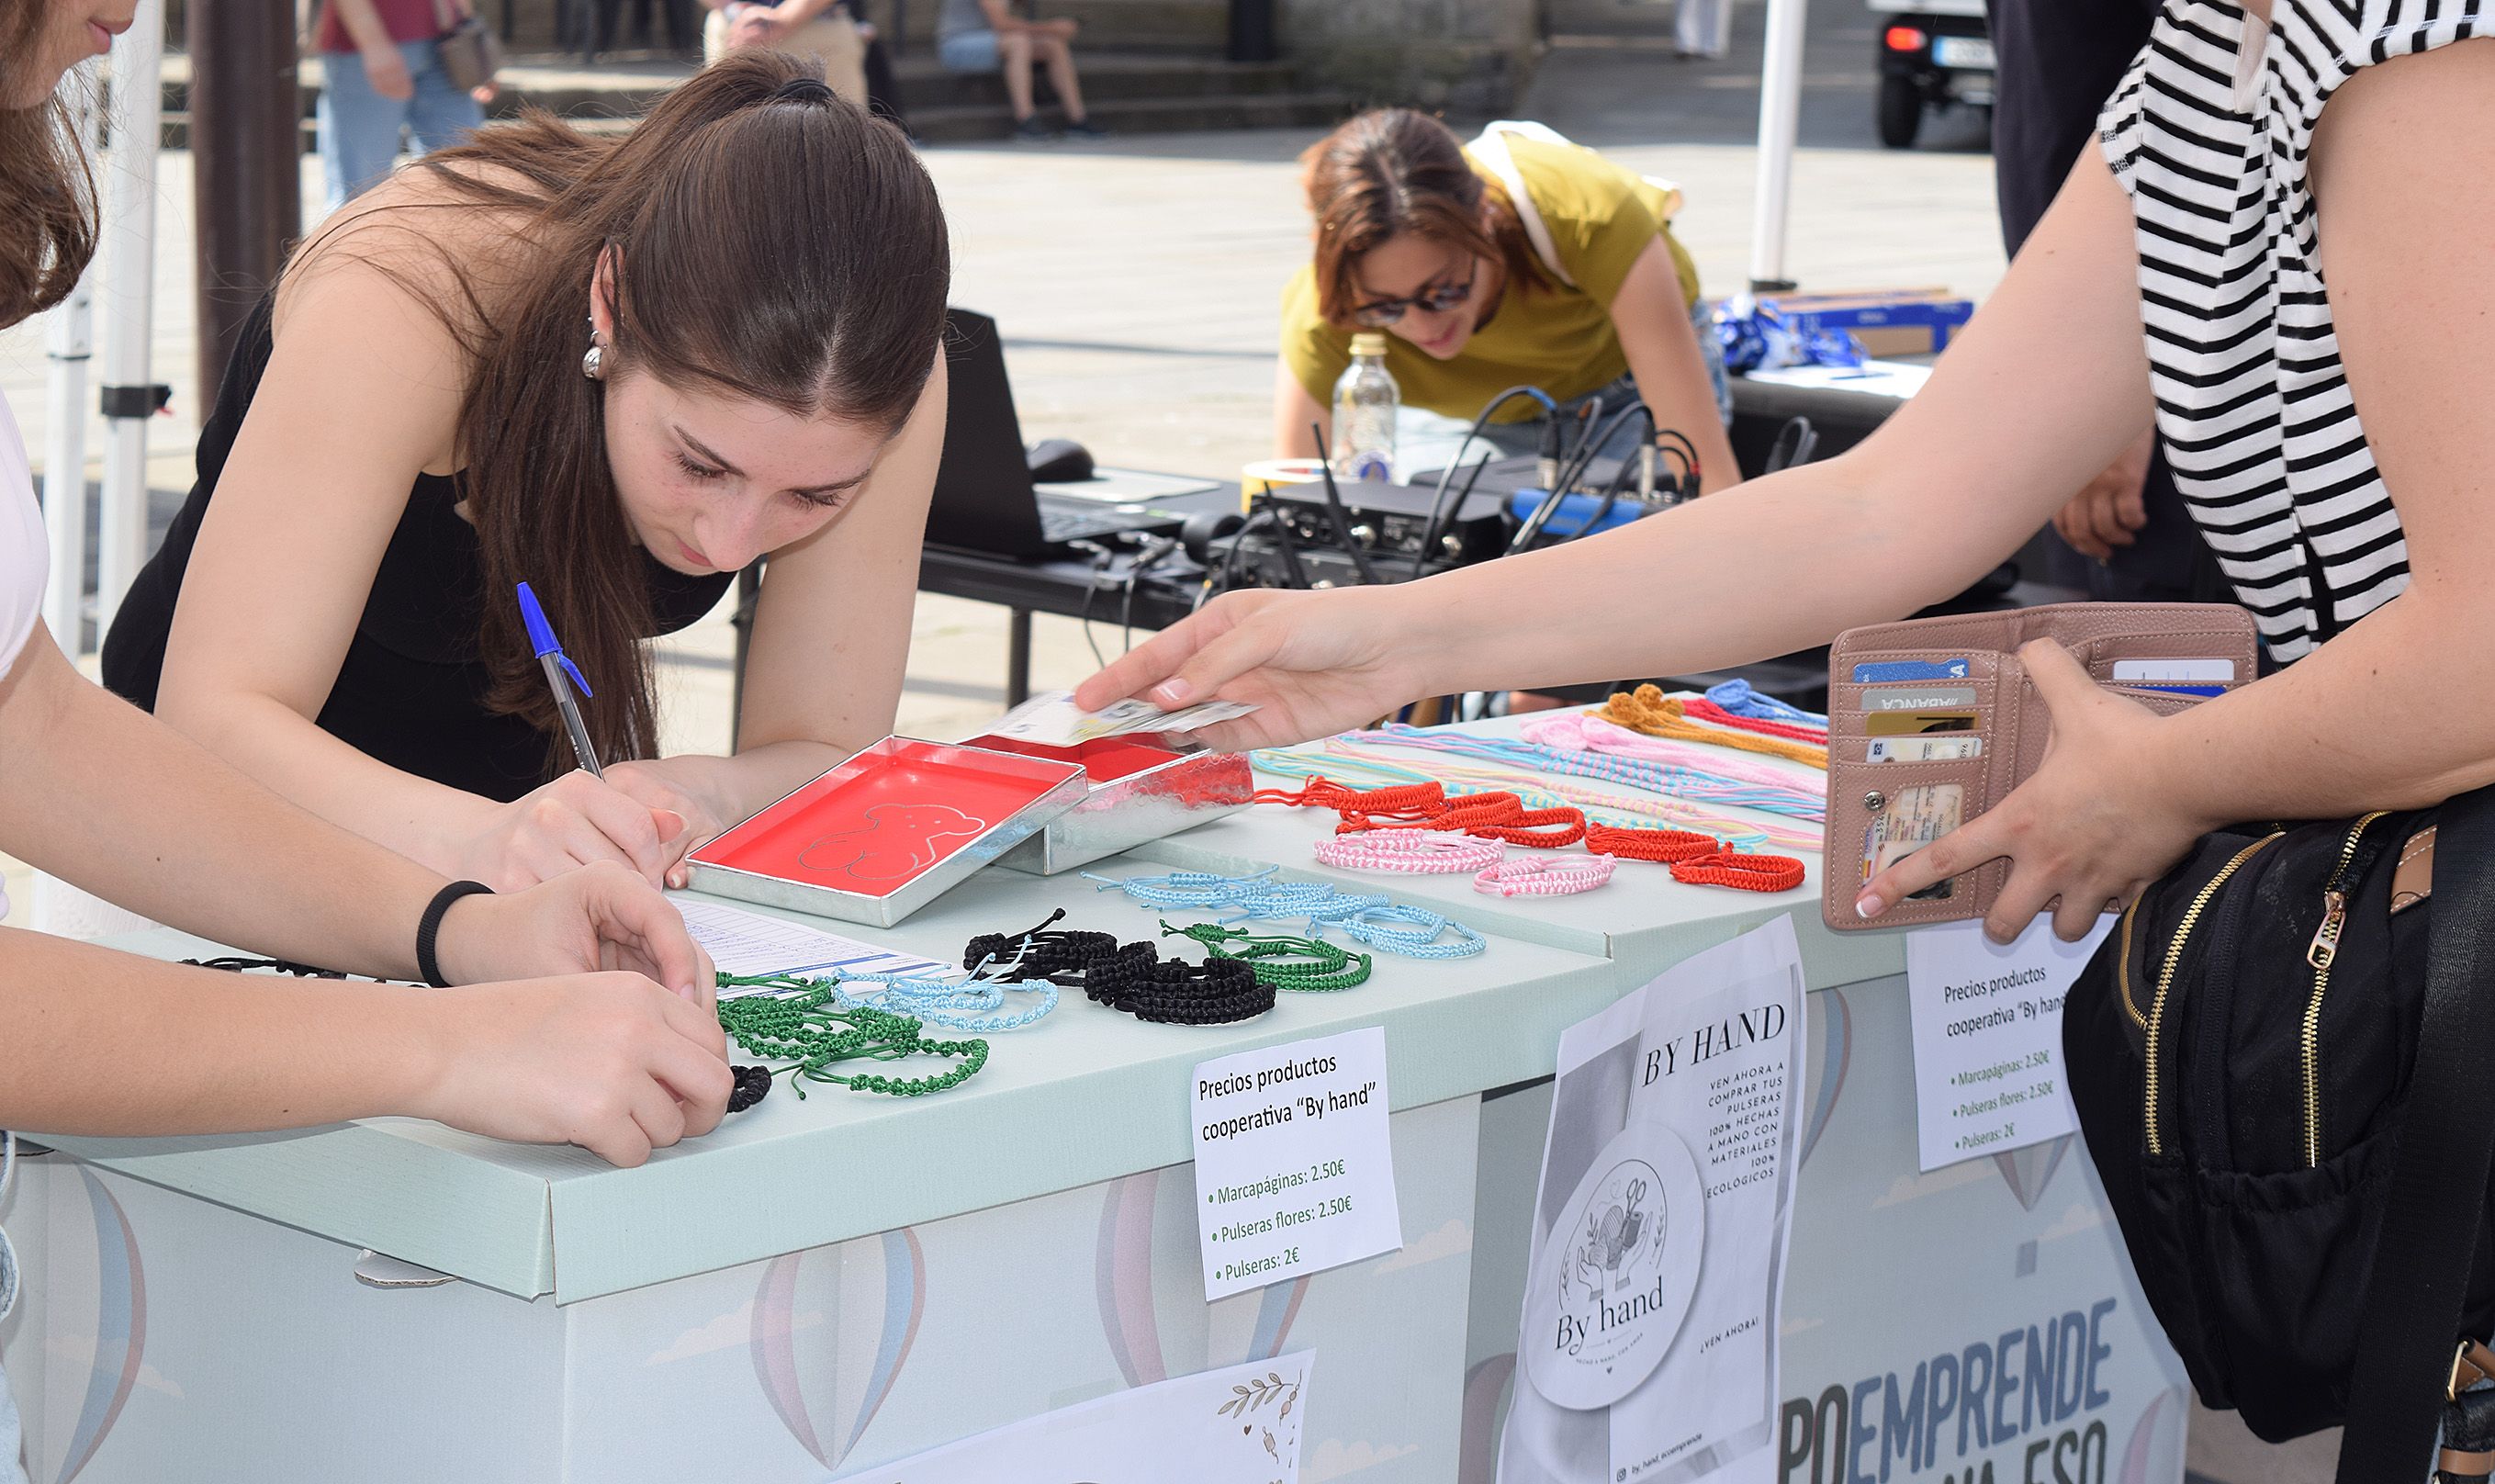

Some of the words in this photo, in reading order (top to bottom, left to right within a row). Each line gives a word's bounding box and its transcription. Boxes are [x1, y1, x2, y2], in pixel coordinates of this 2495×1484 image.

[1944, 980, 1987, 1004] Precios
[1989, 967, 2046, 996] productos
[1947, 1006, 2015, 1037] cooperativa
[1642, 1037, 1683, 1088] BY
[1691, 1004, 1785, 1066] HAND
[1199, 1073, 1253, 1101] Precios
[1257, 1055, 1337, 1092] productos
[1710, 1075, 1730, 1090] VEN
[1734, 1065, 1771, 1083] AHORA
[1777, 1062, 1783, 1071] A
[1958, 1058, 2023, 1086] Marcapáginas:
[2025, 1050, 2051, 1069] 2.50€
[1708, 1083, 1757, 1107] COMPRAR
[1763, 1076, 1782, 1089] TUS
[1727, 1091, 1781, 1115] PULSERAS
[1960, 1096, 1997, 1118] Pulseras
[1999, 1090, 2026, 1108] flores:
[2029, 1080, 2054, 1099] 2.50€
[1202, 1105, 1292, 1141] cooperativa
[1708, 1143, 1714, 1152] A
[1717, 1130, 1749, 1148] MANO
[1754, 1121, 1778, 1137] CON
[1709, 1123, 1731, 1137] 100%
[1736, 1106, 1779, 1127] HECHAS
[1961, 1130, 2002, 1150] Pulseras:
[2004, 1122, 2015, 1138] 2€
[1711, 1137, 1776, 1166] MATERIALES
[1751, 1153, 1774, 1167] 100%
[1218, 1171, 1308, 1204] Marcapáginas:
[1310, 1159, 1346, 1183] 2.50€
[1221, 1219, 1273, 1242] Pulseras
[1276, 1207, 1315, 1230] flores:
[1319, 1195, 1353, 1219] 2.50€
[1225, 1254, 1280, 1280] Pulseras:
[1284, 1247, 1300, 1265] 2€
[1554, 1314, 1591, 1355] By
[1599, 1275, 1664, 1332] hand
[1725, 1315, 1759, 1338] AHORA!
